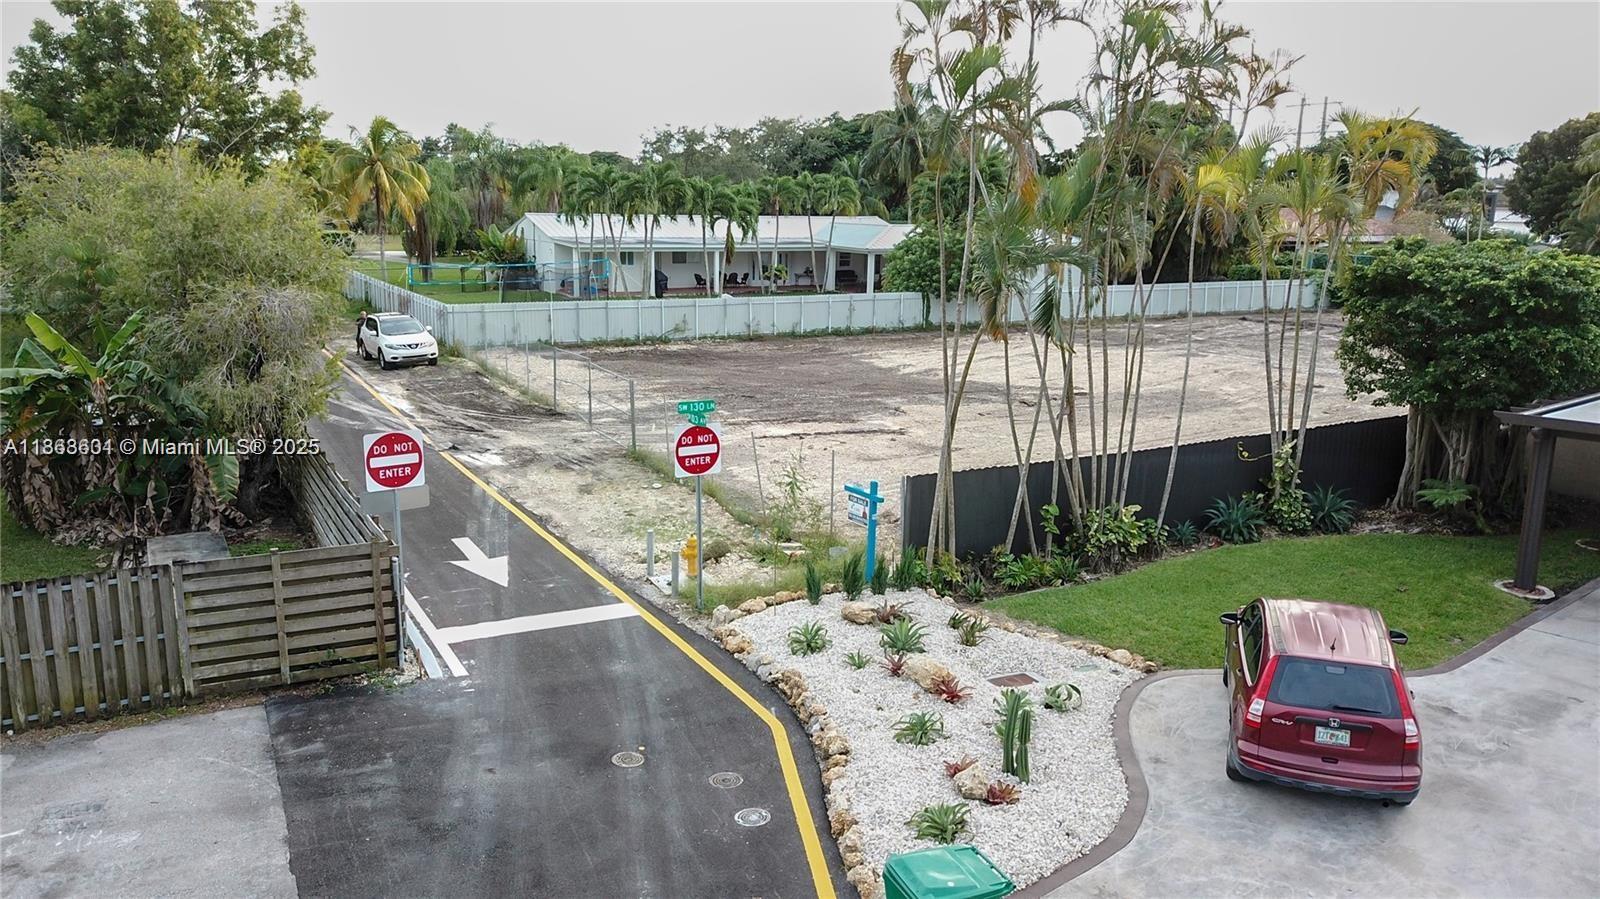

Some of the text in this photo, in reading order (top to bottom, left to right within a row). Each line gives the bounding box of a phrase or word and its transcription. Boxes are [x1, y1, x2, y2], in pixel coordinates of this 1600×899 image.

[690, 402, 704, 412] 130
[706, 402, 714, 410] LN
[681, 434, 713, 444] DO NOT
[373, 442, 413, 454] DO NOT
[685, 456, 711, 466] ENTER
[379, 467, 411, 479] ENTER
